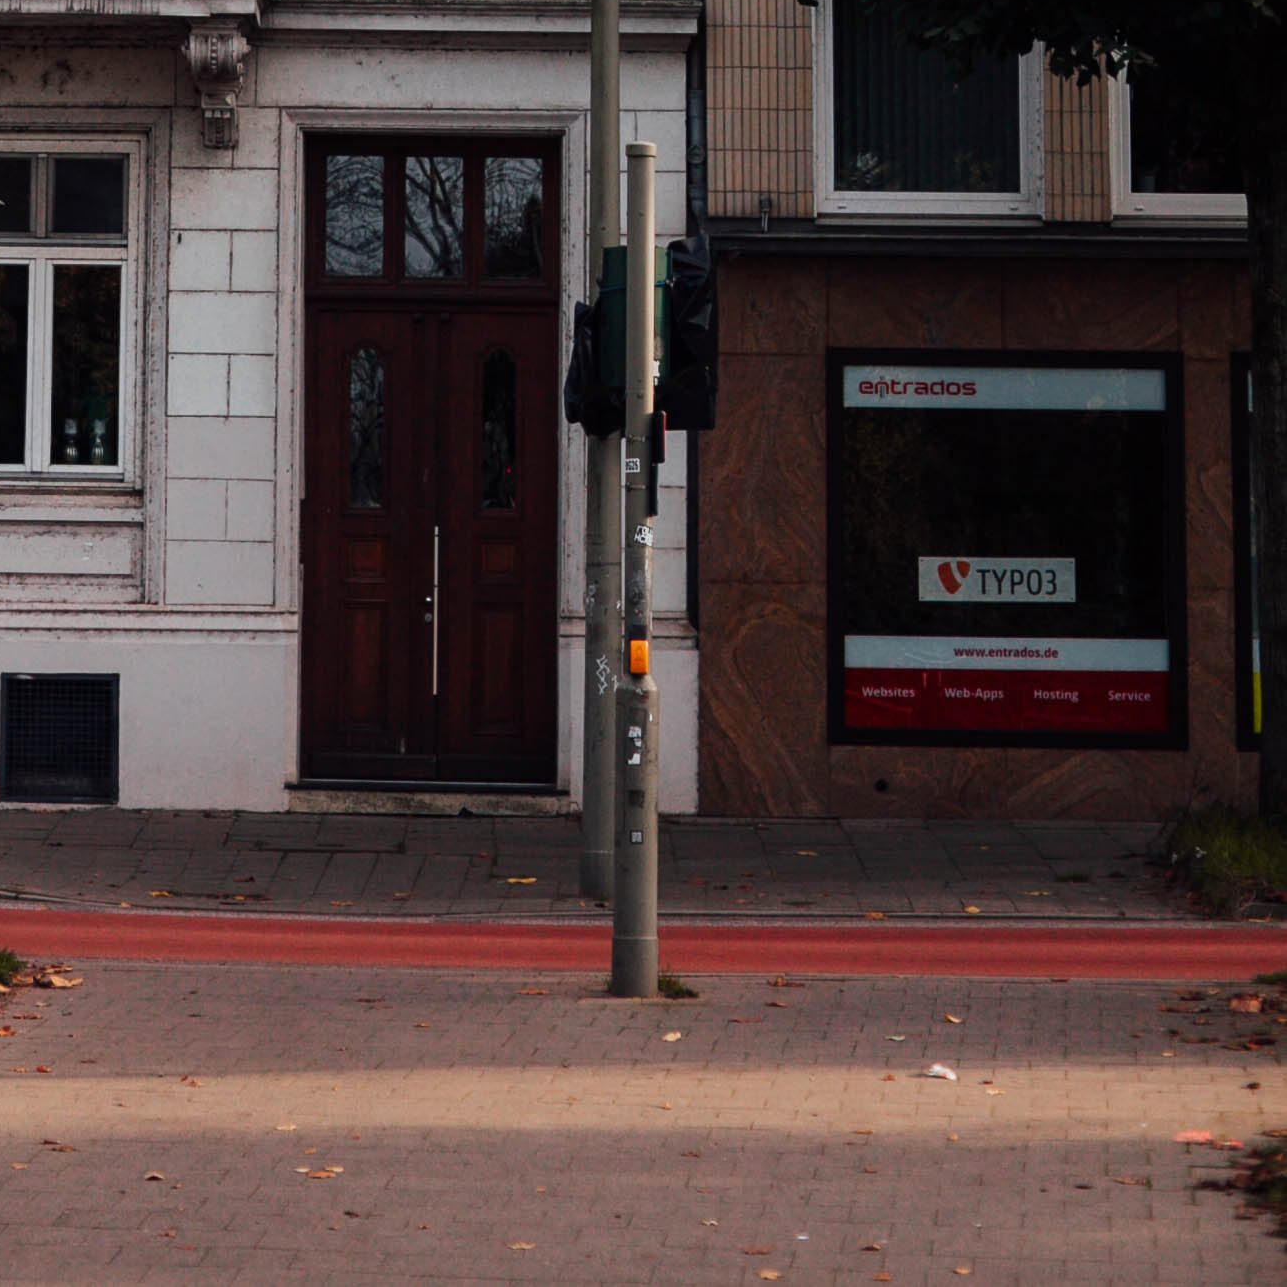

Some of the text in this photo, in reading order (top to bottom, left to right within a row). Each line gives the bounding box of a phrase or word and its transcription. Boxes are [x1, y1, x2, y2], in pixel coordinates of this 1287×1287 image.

[858, 378, 978, 397] entrados
[976, 568, 1058, 596] TYPO3
[953, 646, 1059, 659] www.entrados.de
[862, 686, 1151, 703] Websites Web-Apps Hosting Service
